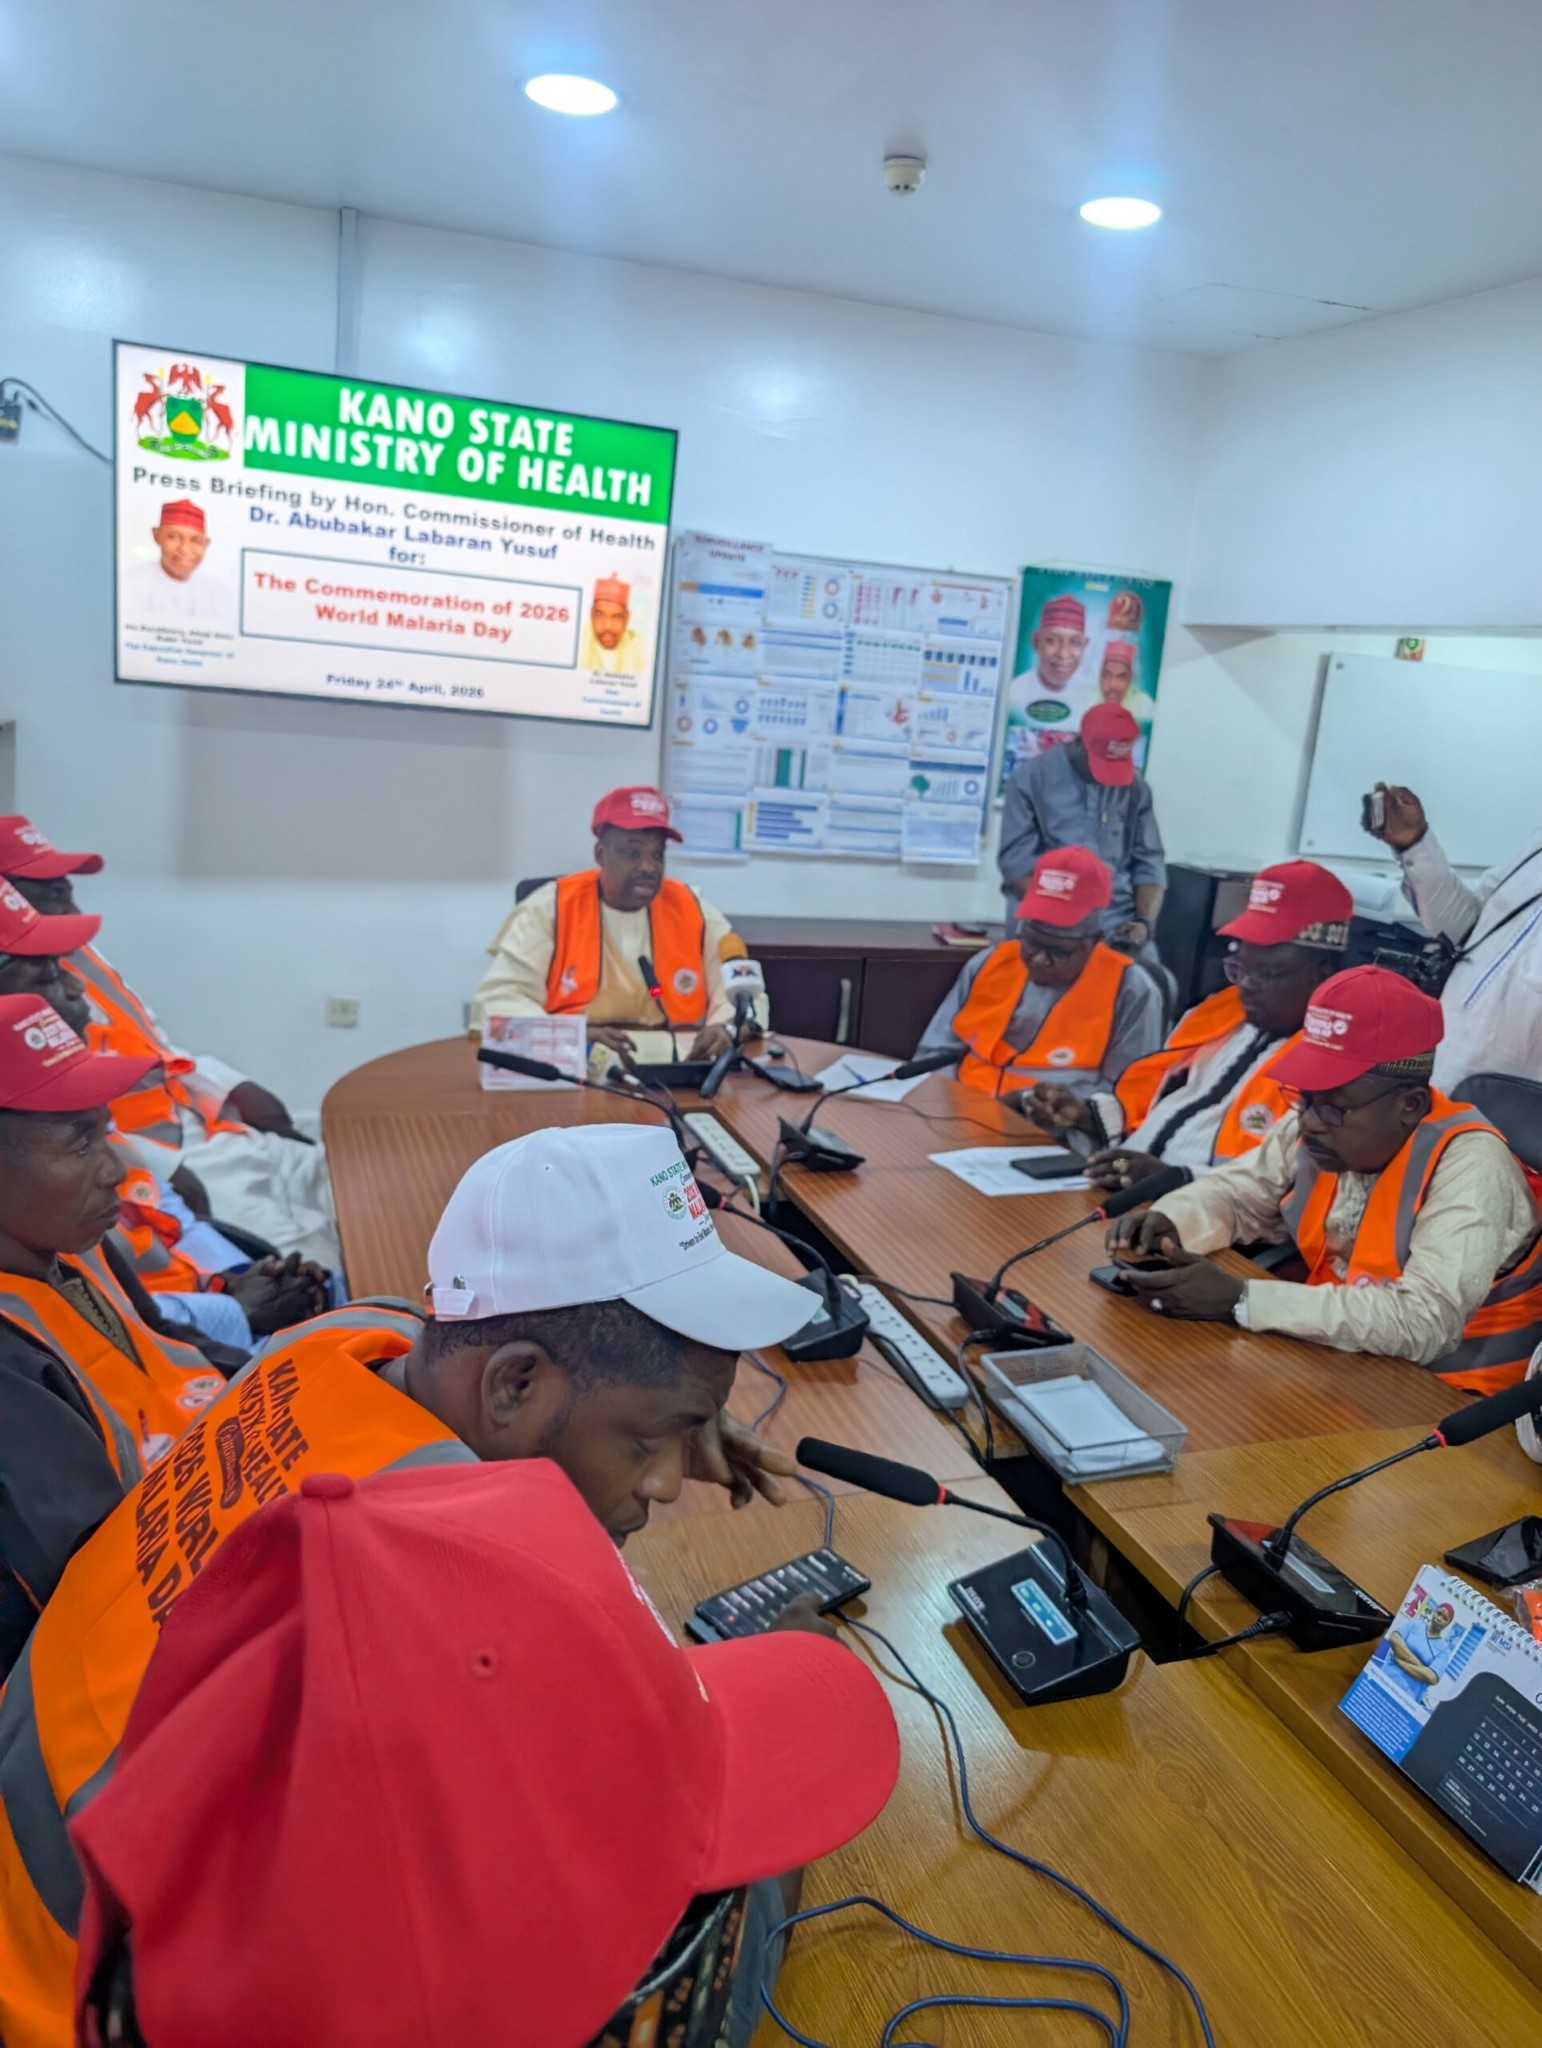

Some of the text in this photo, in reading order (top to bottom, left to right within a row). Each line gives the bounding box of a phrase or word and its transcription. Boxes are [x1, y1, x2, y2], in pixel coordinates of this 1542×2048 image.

[339, 387, 574, 457] KANO STATE
[245, 415, 652, 507] MINISTRY OF HEALTH
[133, 467, 656, 551] Press Briefing by Hon. Commissioner of Health
[250, 506, 559, 560] Dr. Abubakar Labaran Yusuf
[389, 546, 427, 566] for:
[254, 572, 570, 623] The Commemoration of 2026
[315, 604, 512, 643] World Malaria Day
[326, 674, 371, 691] Friday
[650, 1169, 669, 1187] KANO
[667, 1160, 685, 1178] STATE
[266, 1358, 300, 1410] KAN
[242, 1440, 288, 1505] HEALT
[176, 1471, 219, 1578] WORL
